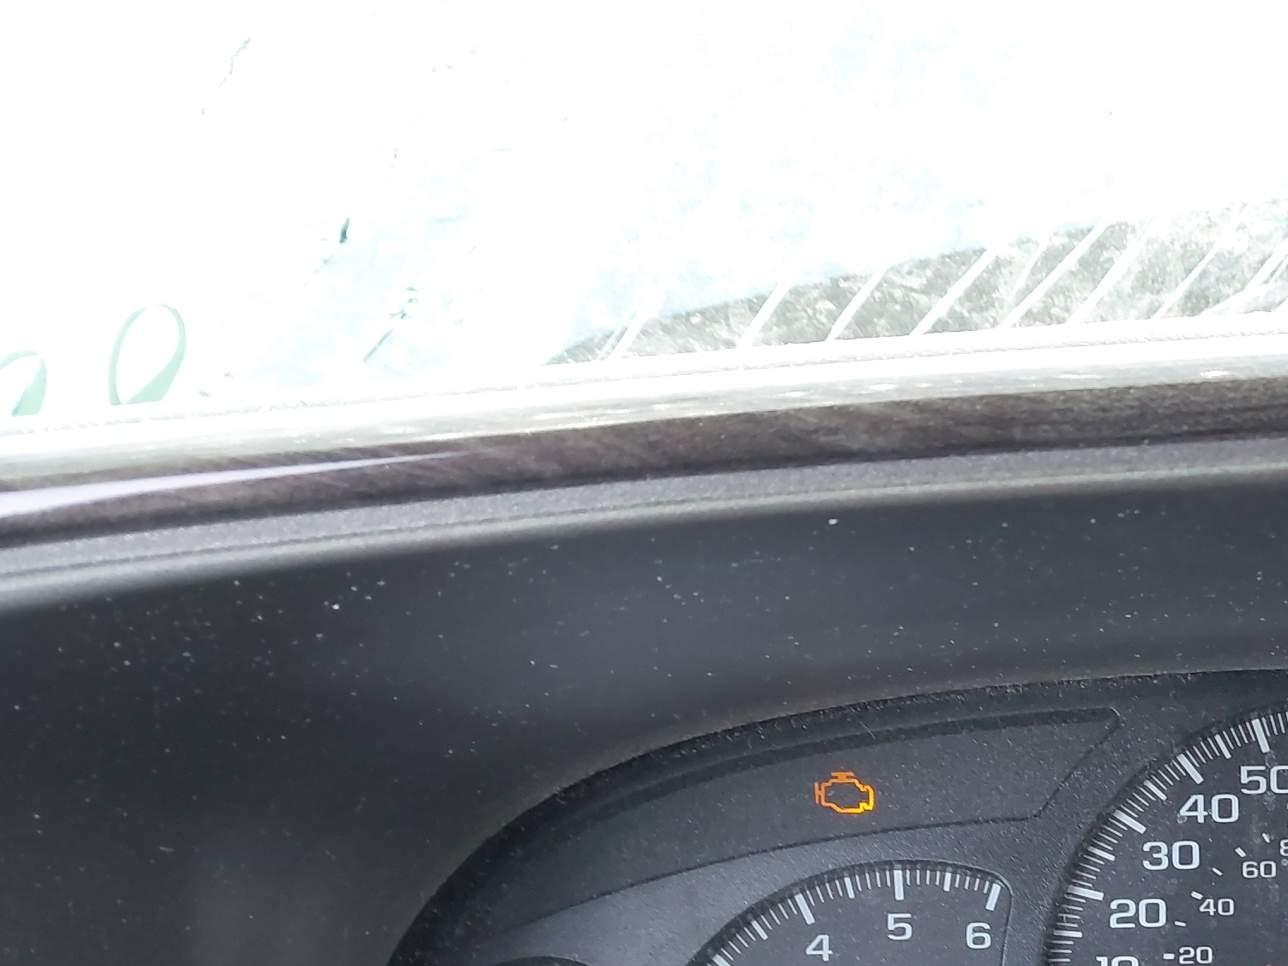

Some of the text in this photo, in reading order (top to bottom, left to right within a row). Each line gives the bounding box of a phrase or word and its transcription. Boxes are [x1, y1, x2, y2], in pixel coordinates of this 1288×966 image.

[1179, 794, 1239, 823] 40
[1142, 841, 1200, 869] 30
[1242, 860, 1276, 878] 60
[1109, 899, 1166, 928] 20
[1199, 898, 1234, 916] 40
[887, 913, 912, 941] 5
[966, 923, 992, 949] 6
[805, 935, 833, 962] 4
[1178, 947, 1212, 965] 20
